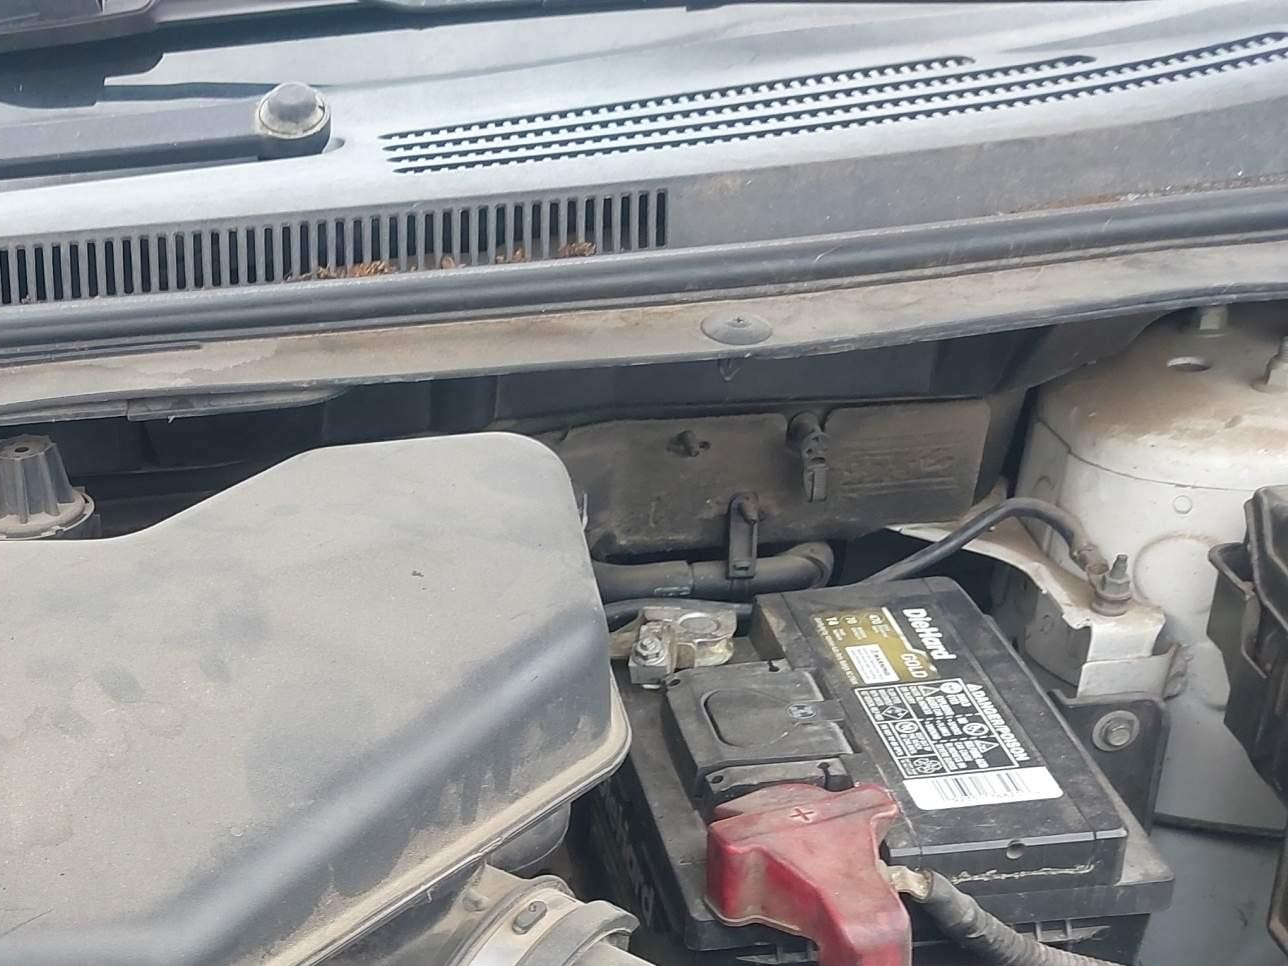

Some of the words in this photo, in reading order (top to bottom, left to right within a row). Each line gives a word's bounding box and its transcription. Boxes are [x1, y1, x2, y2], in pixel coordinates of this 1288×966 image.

[902, 607, 958, 661] DieHard
[900, 652, 929, 679] GOLD
[973, 691, 1031, 762] DANGER/POISON
